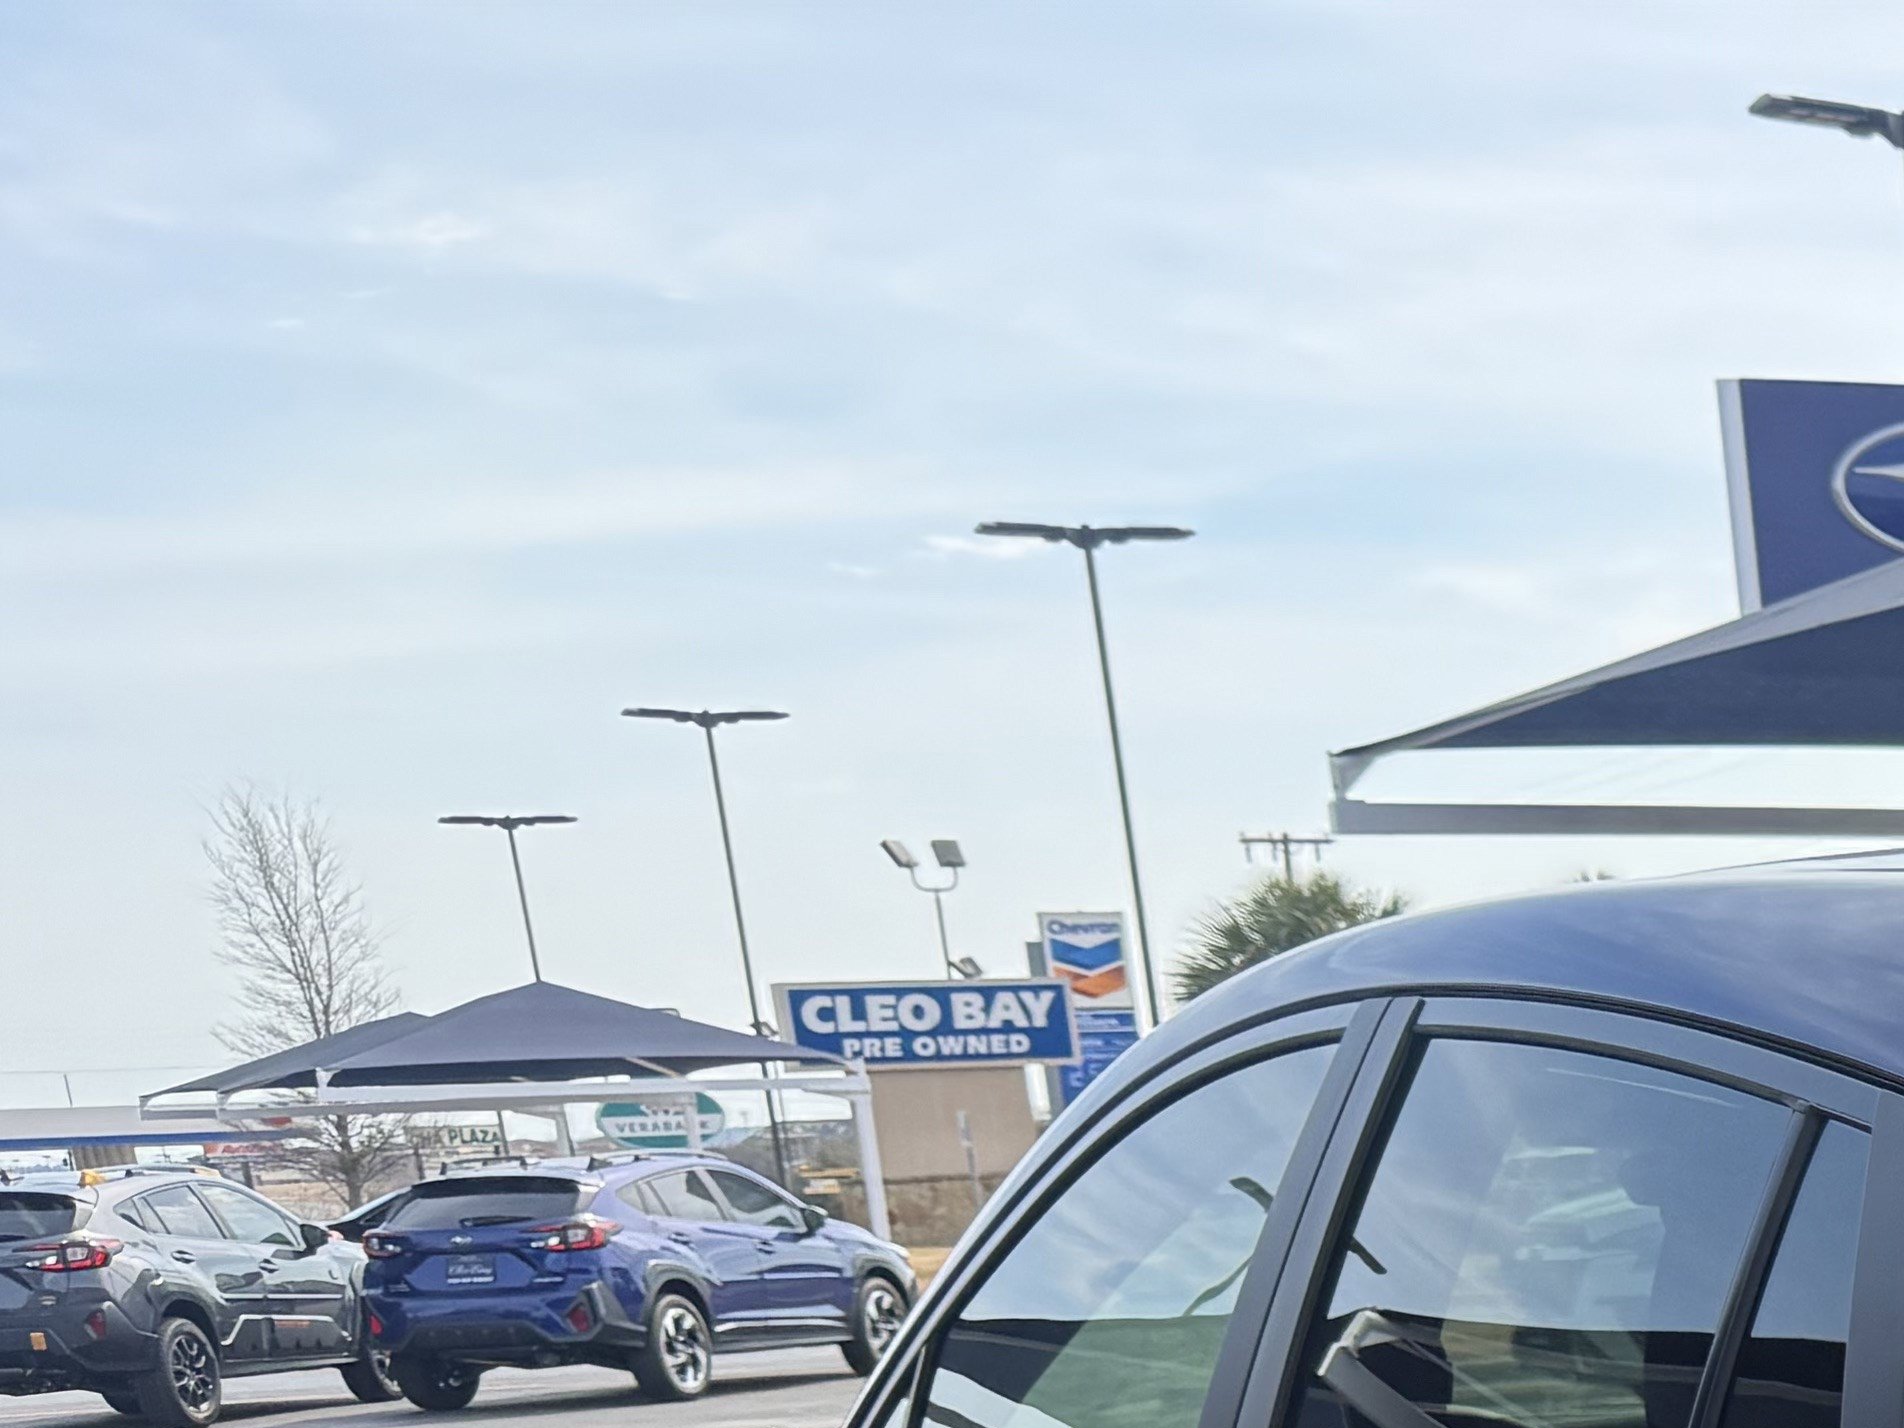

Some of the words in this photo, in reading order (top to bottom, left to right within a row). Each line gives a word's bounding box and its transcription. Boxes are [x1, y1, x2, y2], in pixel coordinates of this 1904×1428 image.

[801, 993, 942, 1034] CLEO
[950, 991, 1056, 1029] BAY
[843, 1037, 904, 1059] PRE
[912, 1033, 1031, 1056] OWNED
[448, 1128, 502, 1145] PLAZA
[615, 1120, 708, 1133] VERABAK
